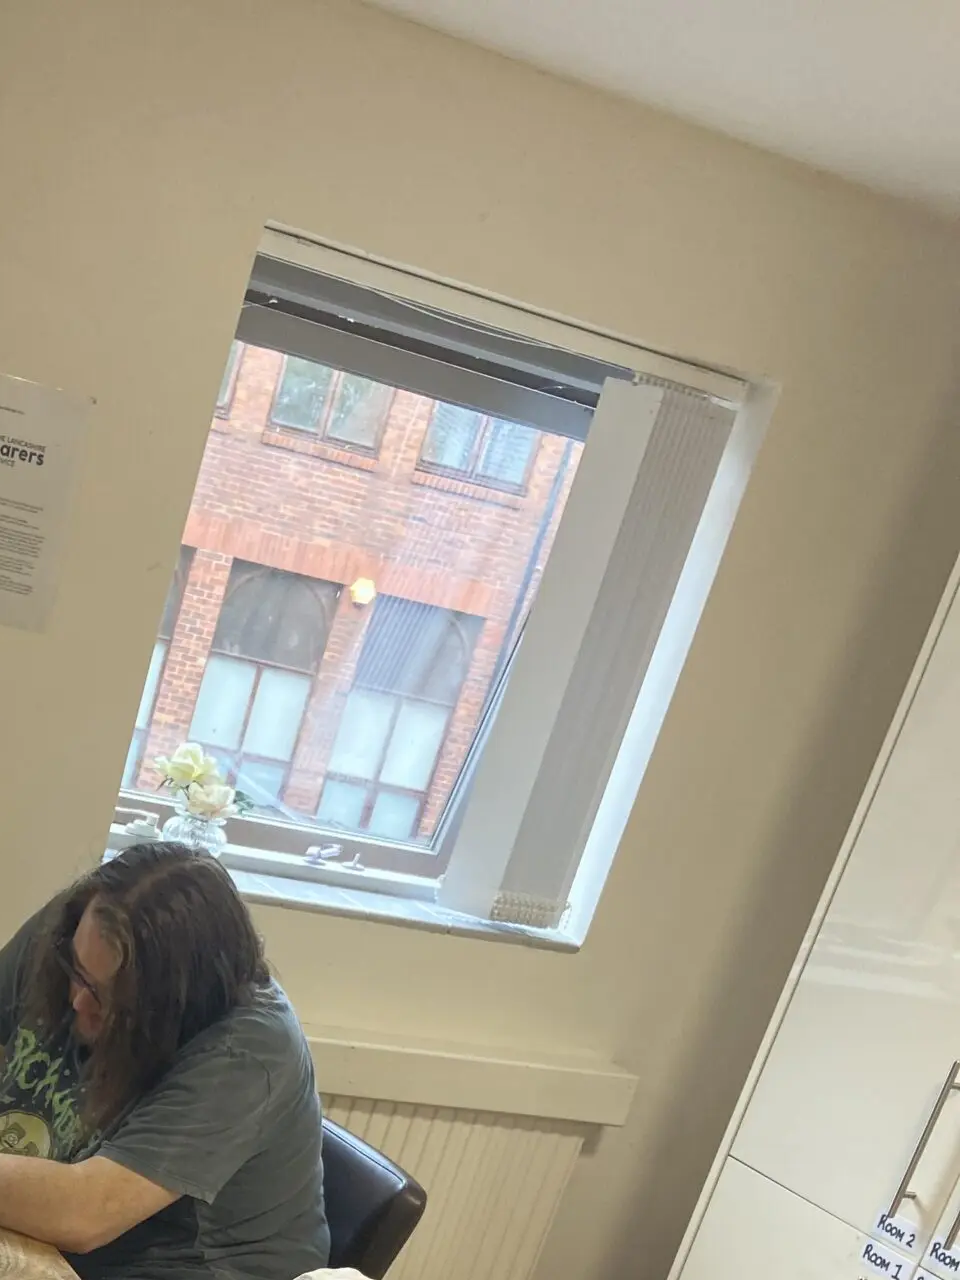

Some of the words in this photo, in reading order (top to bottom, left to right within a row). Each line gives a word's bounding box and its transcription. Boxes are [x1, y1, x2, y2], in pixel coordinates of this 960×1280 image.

[877, 1214, 906, 1242] ROOM
[906, 1233, 916, 1248] 2
[862, 1244, 891, 1271] ROOM
[891, 1264, 903, 1280] 1
